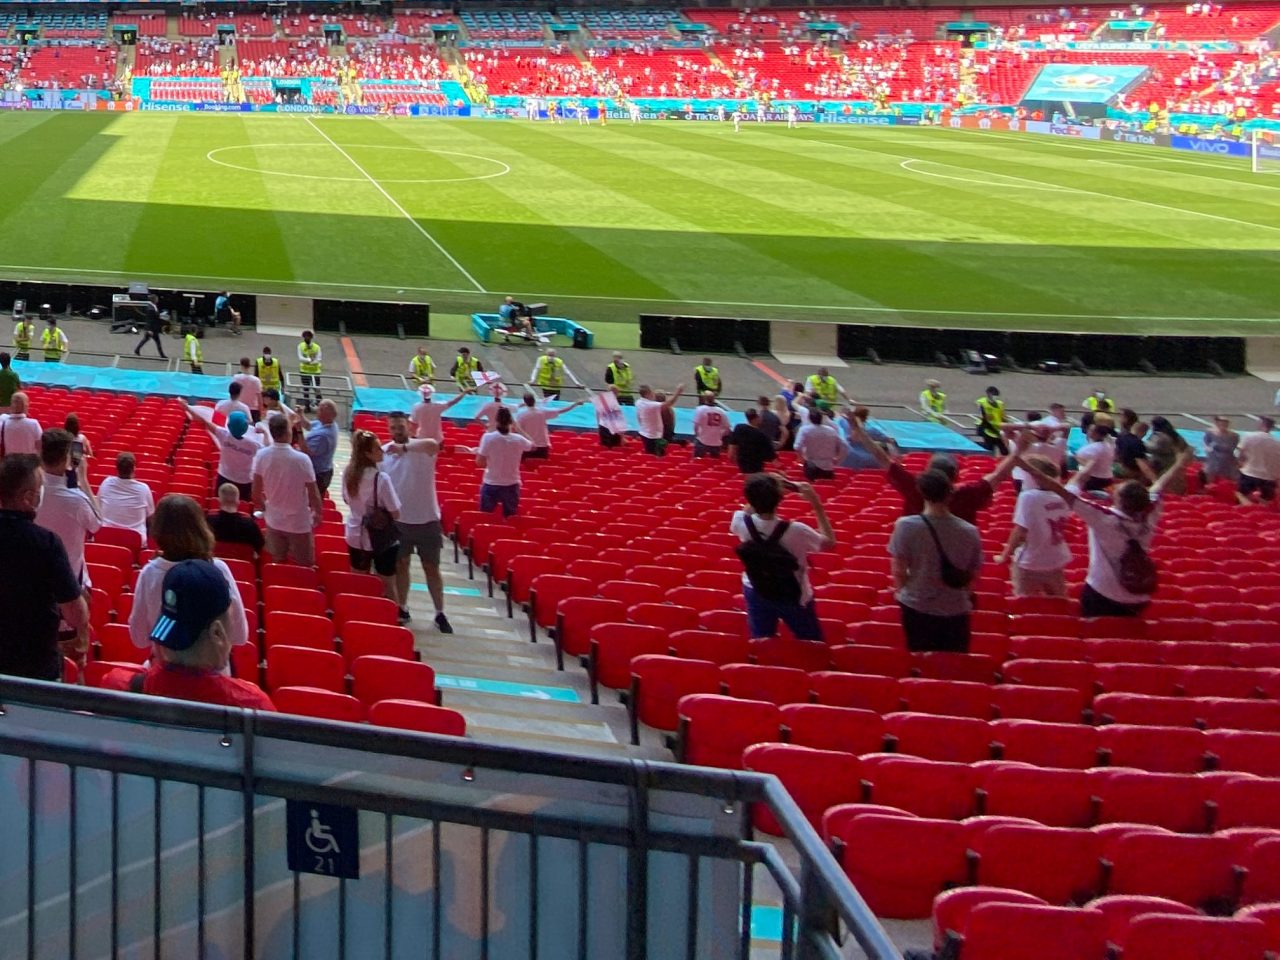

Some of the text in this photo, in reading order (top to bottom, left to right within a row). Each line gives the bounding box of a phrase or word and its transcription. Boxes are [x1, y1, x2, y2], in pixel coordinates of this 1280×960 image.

[142, 102, 190, 112] Hisense
[820, 113, 889, 125] Hisense
[1049, 124, 1082, 137] FedEx
[1124, 132, 1155, 145] TikTok
[314, 856, 335, 873] 21
